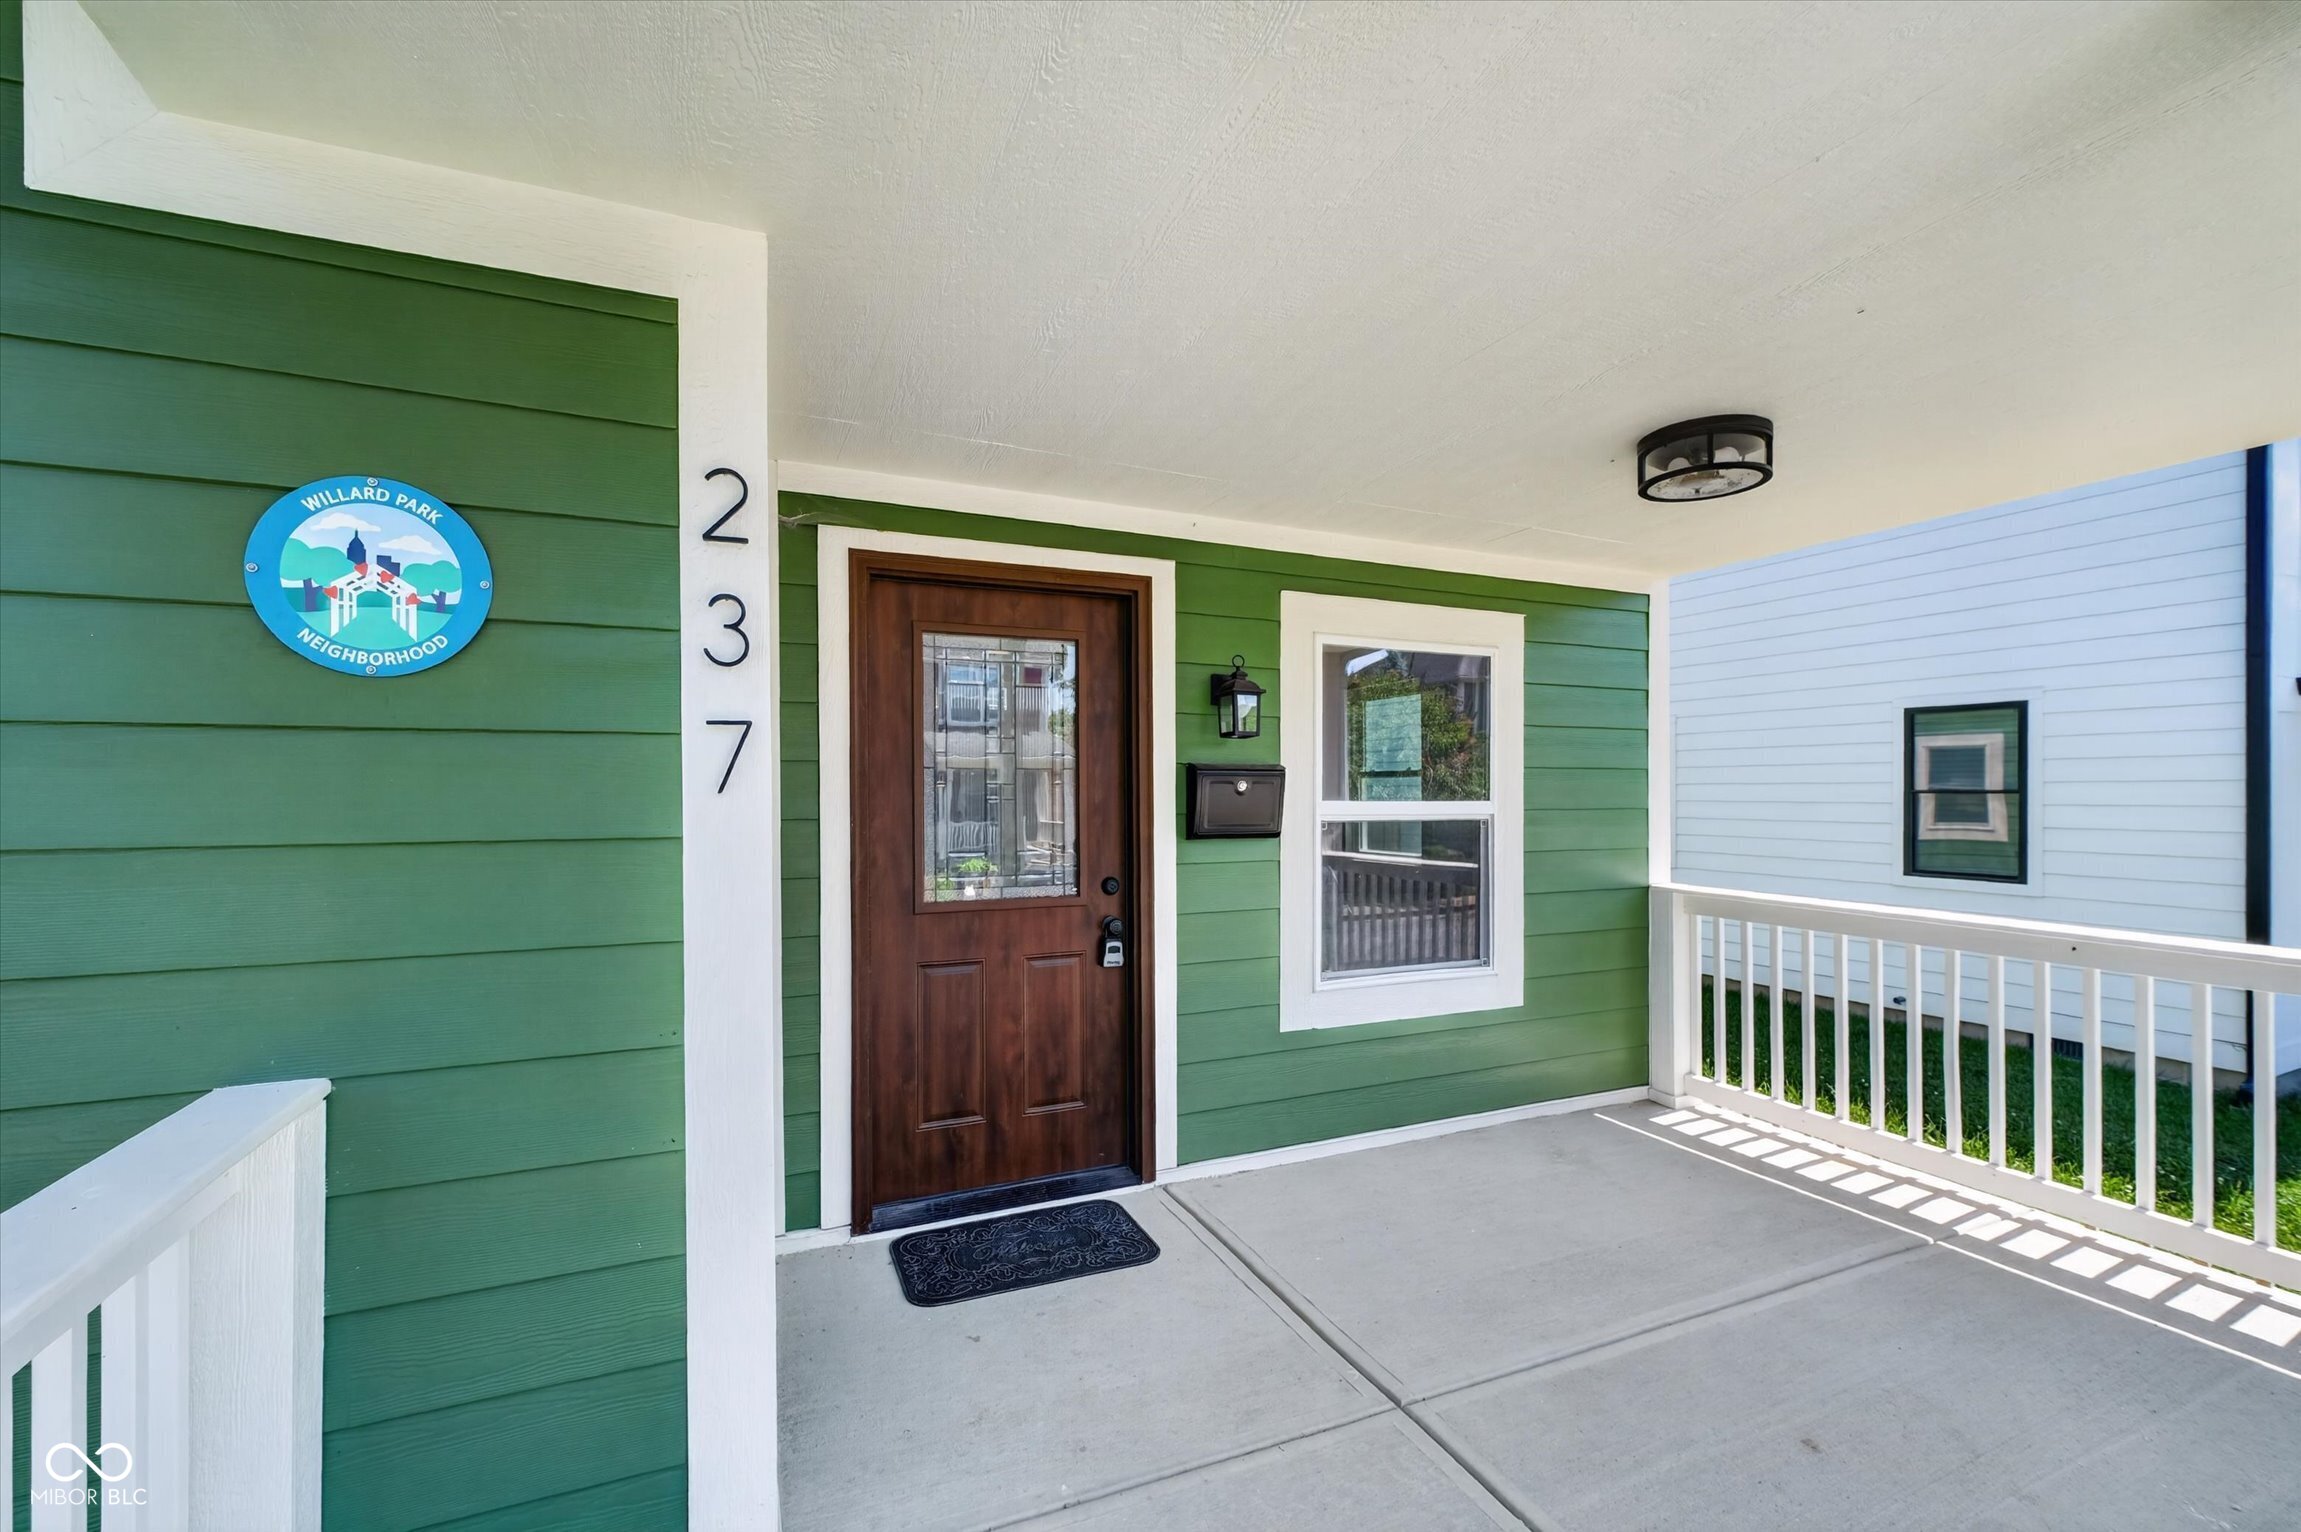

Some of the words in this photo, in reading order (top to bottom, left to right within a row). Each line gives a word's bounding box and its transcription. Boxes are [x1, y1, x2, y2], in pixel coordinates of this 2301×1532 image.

[300, 486, 390, 512] WILLARD
[395, 494, 444, 525] PARK
[296, 627, 449, 666] NEIGHBORHOOD
[702, 467, 753, 795] 237
